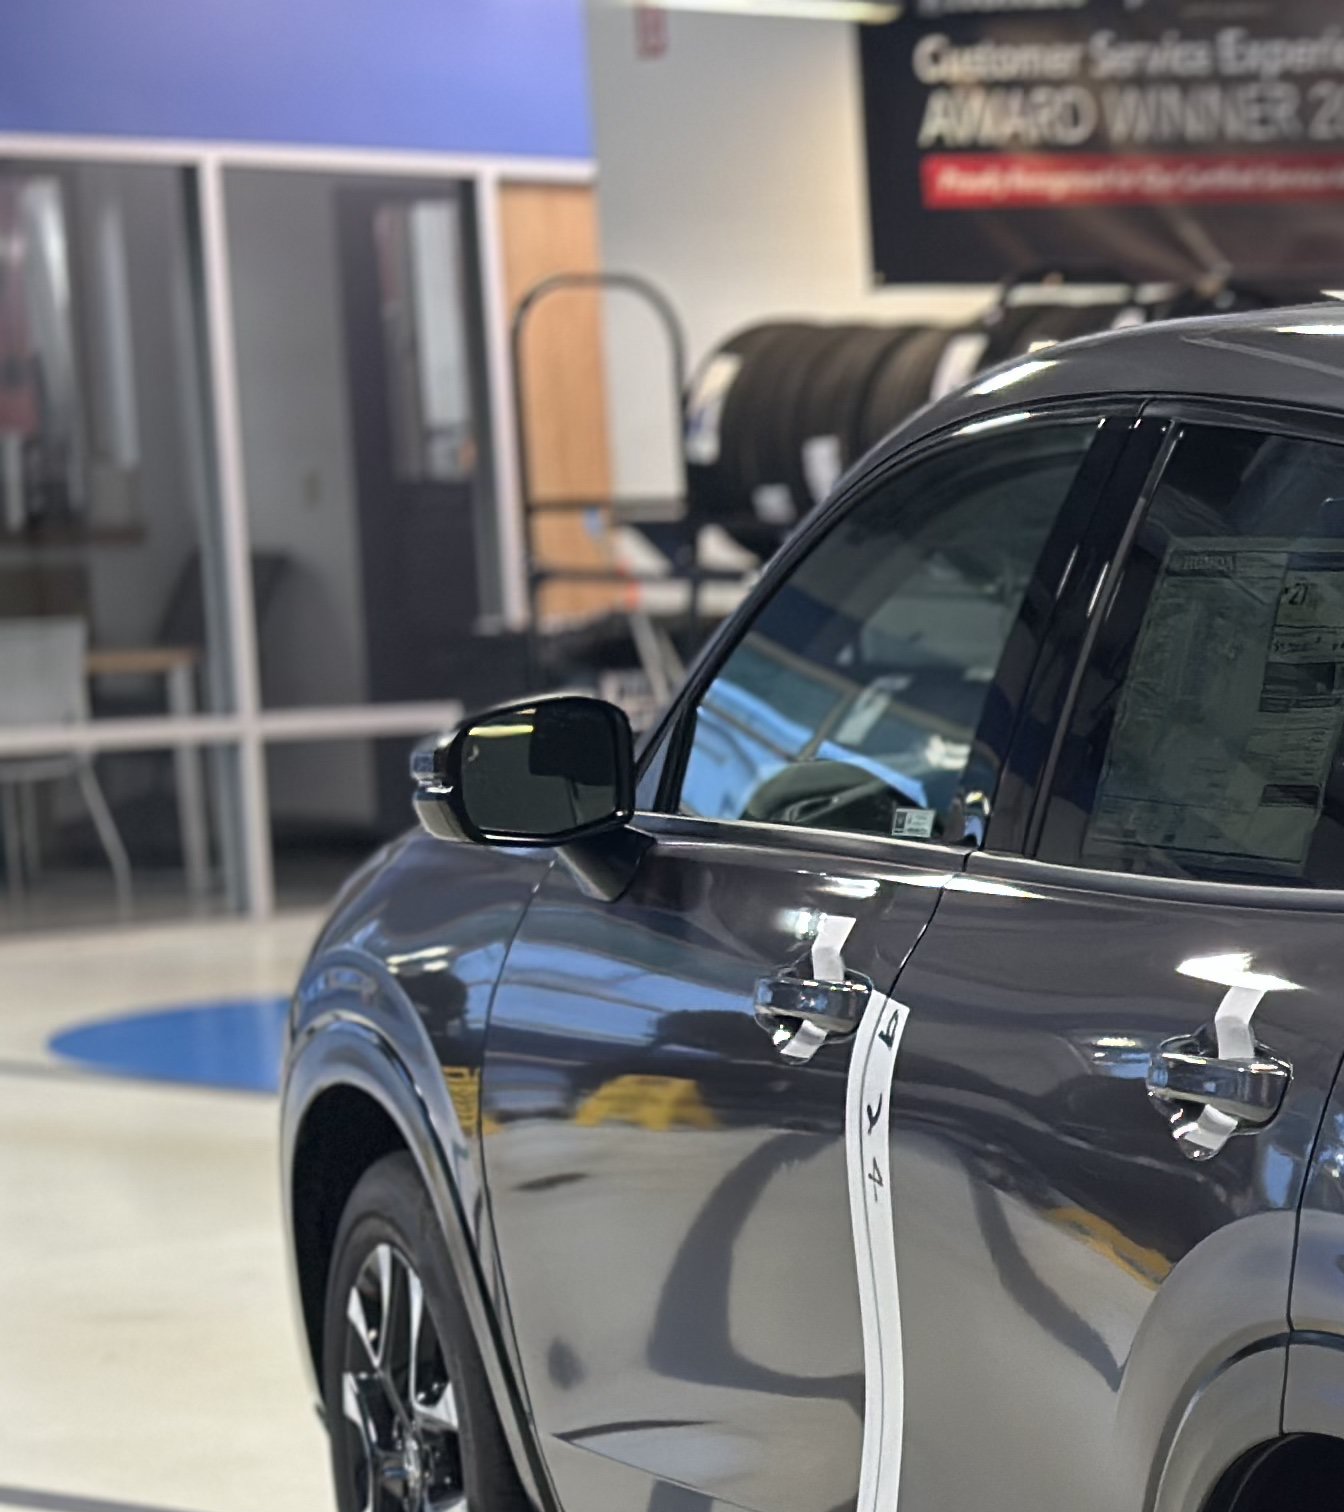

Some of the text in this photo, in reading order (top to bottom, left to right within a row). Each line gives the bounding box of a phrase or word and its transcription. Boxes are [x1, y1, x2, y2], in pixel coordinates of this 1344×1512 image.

[912, 33, 1086, 84] Customer
[1088, 28, 1211, 80] Service
[917, 84, 1098, 148] AWARD
[1101, 80, 1301, 144] WINNER
